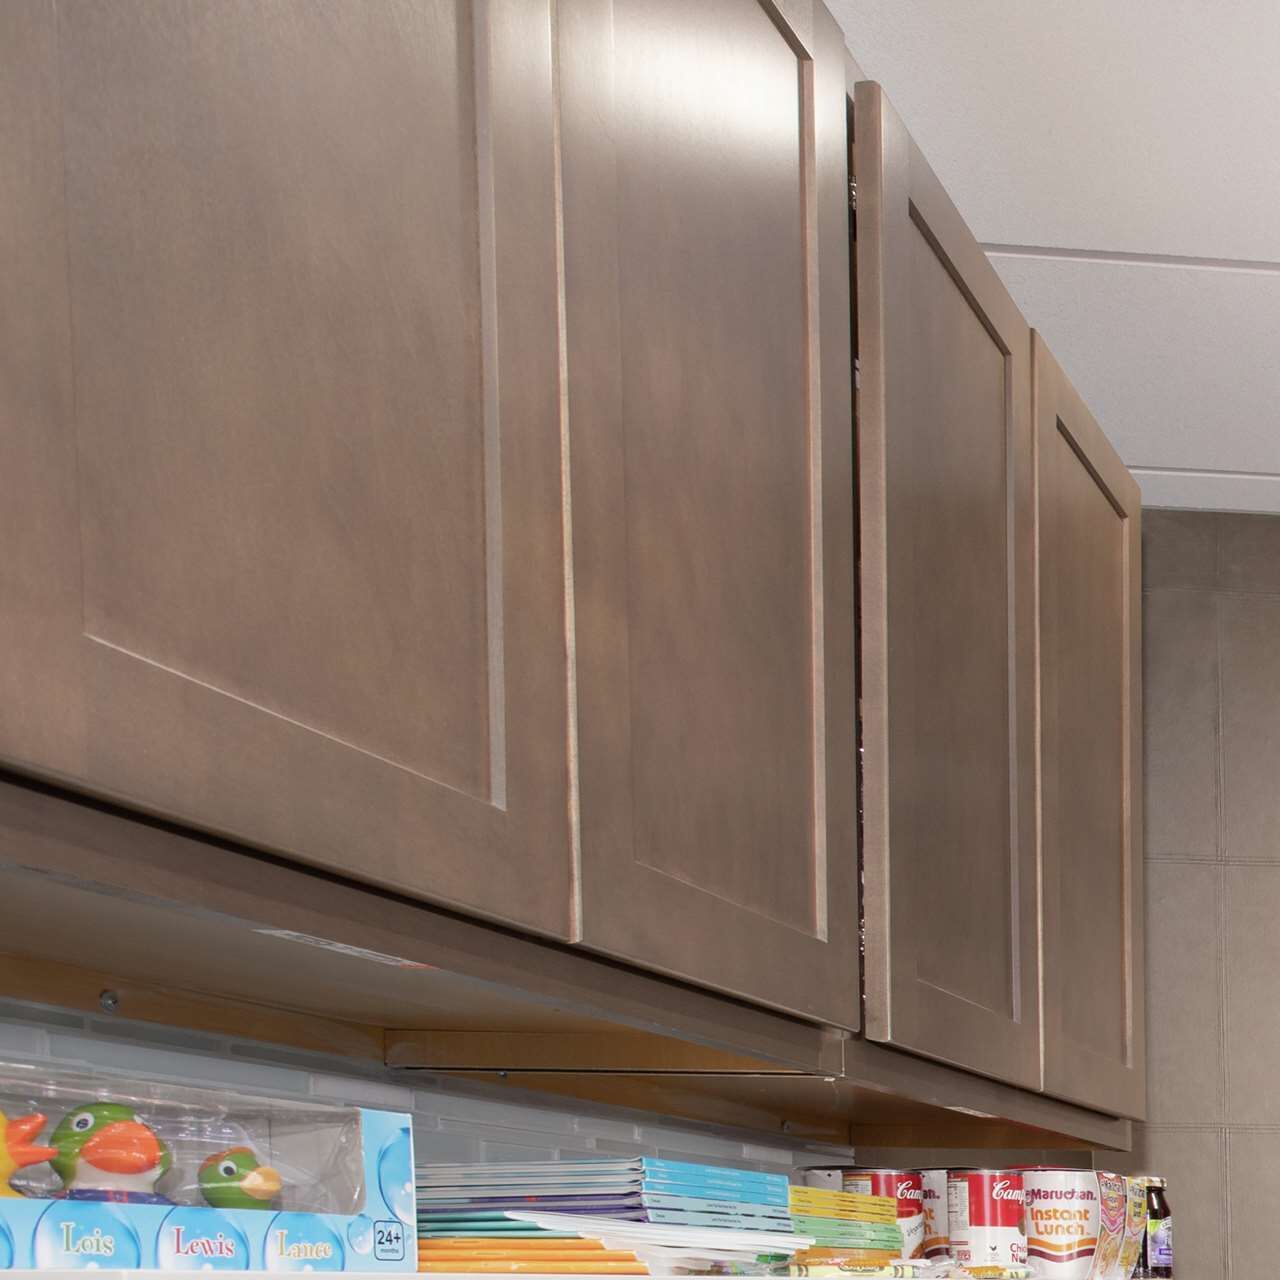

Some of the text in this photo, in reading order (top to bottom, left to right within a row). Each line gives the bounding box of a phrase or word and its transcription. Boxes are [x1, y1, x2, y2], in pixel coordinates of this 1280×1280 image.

[1031, 1207, 1090, 1221] Instant
[61, 1222, 114, 1254] Lois
[377, 1230, 402, 1247] 24+
[1036, 1221, 1085, 1235] Lunch
[174, 1227, 235, 1257] Lewis
[277, 1230, 332, 1258] Lance
